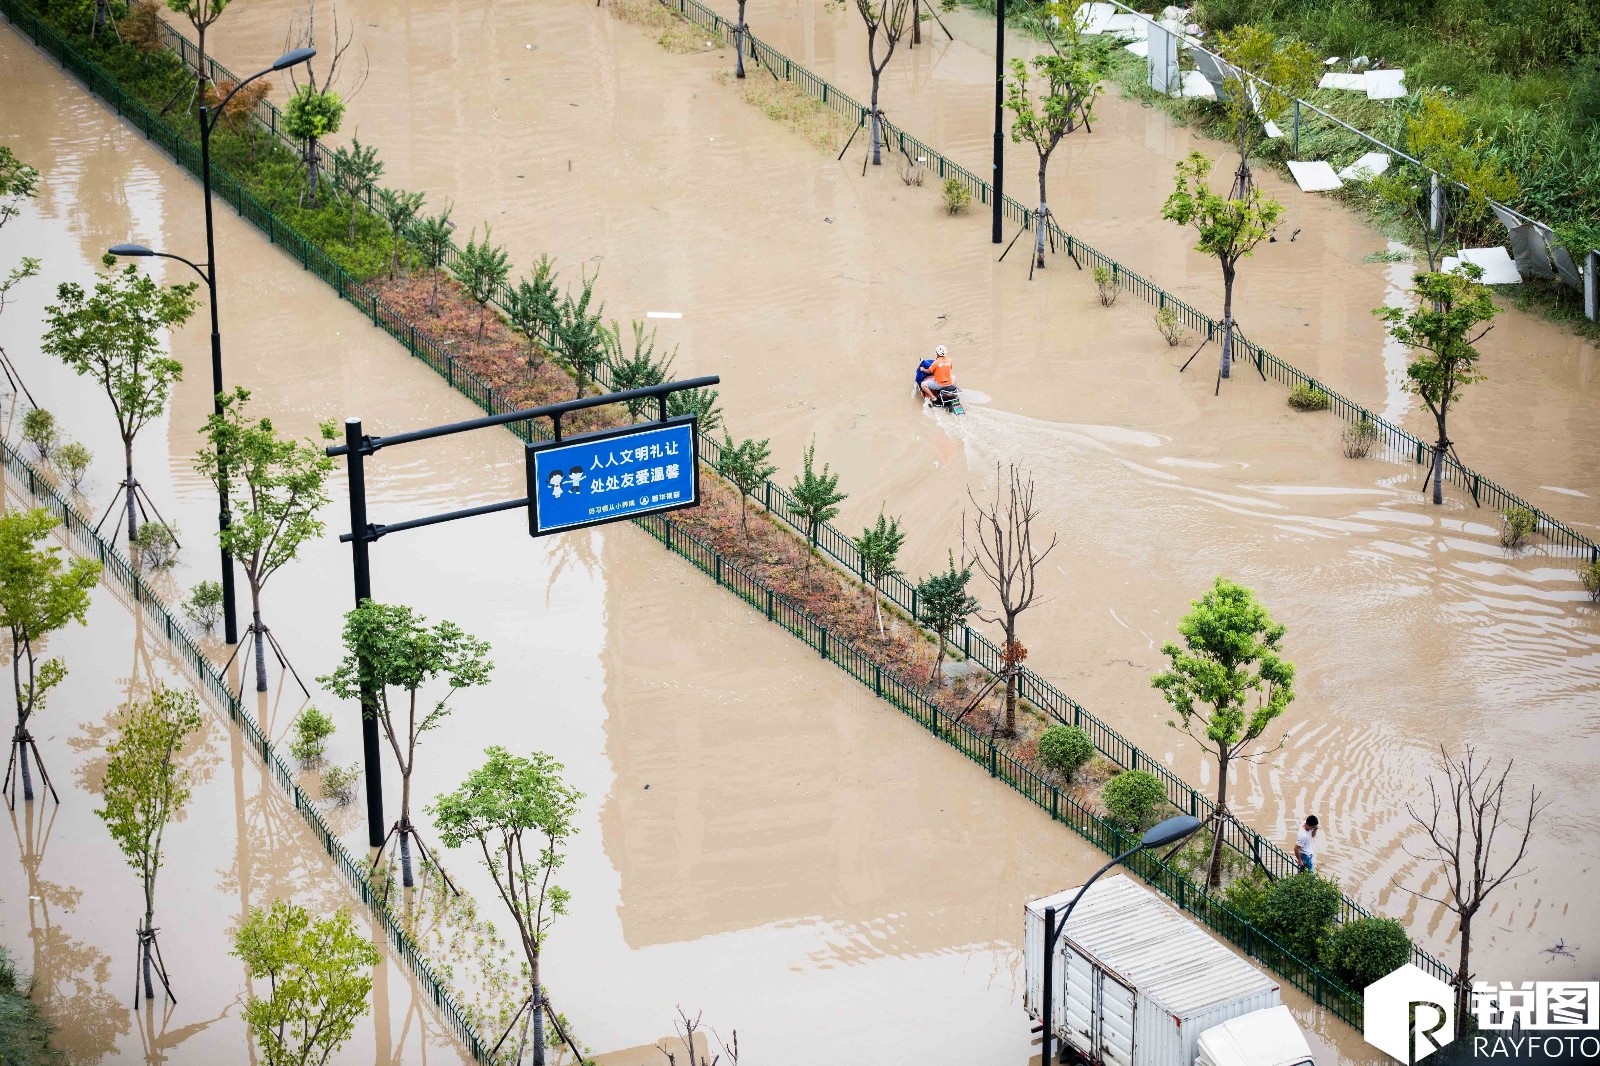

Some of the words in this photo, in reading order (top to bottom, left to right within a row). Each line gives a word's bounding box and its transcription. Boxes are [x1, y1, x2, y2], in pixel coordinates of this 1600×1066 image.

[590, 441, 679, 470] 人人文明礼让
[590, 464, 680, 495] 处处友爱温馨
